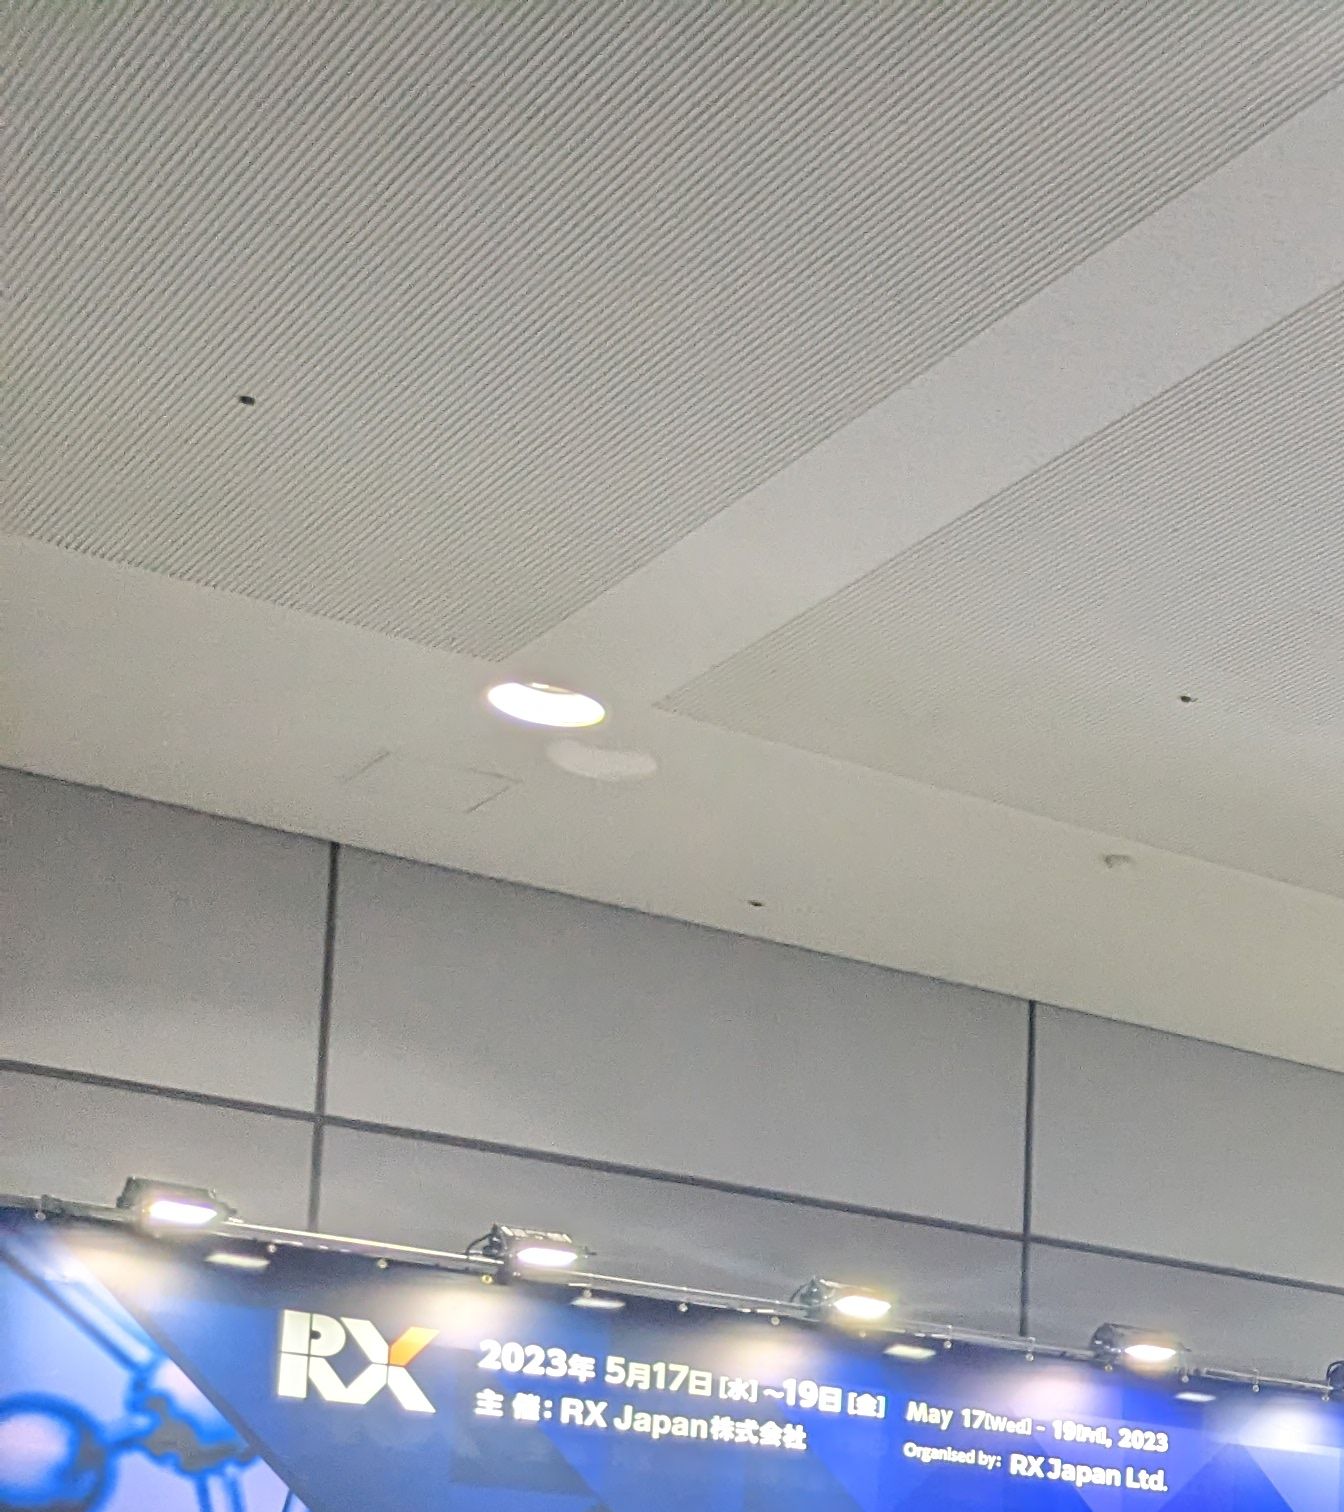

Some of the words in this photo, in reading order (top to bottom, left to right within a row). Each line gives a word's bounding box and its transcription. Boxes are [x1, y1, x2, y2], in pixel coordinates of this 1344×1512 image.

[277, 1309, 440, 1414] RX
[477, 1338, 597, 1384] 2023年
[605, 1356, 713, 1398] 5月17日
[560, 1397, 608, 1428] RX
[906, 1400, 954, 1431] May
[1118, 1427, 1169, 1453] 2023
[903, 1441, 976, 1463] Organised
[977, 1449, 1002, 1470] by:
[1010, 1453, 1045, 1479] RX
[1046, 1457, 1122, 1488] Japan
[1125, 1466, 1168, 1492] Ltd.
